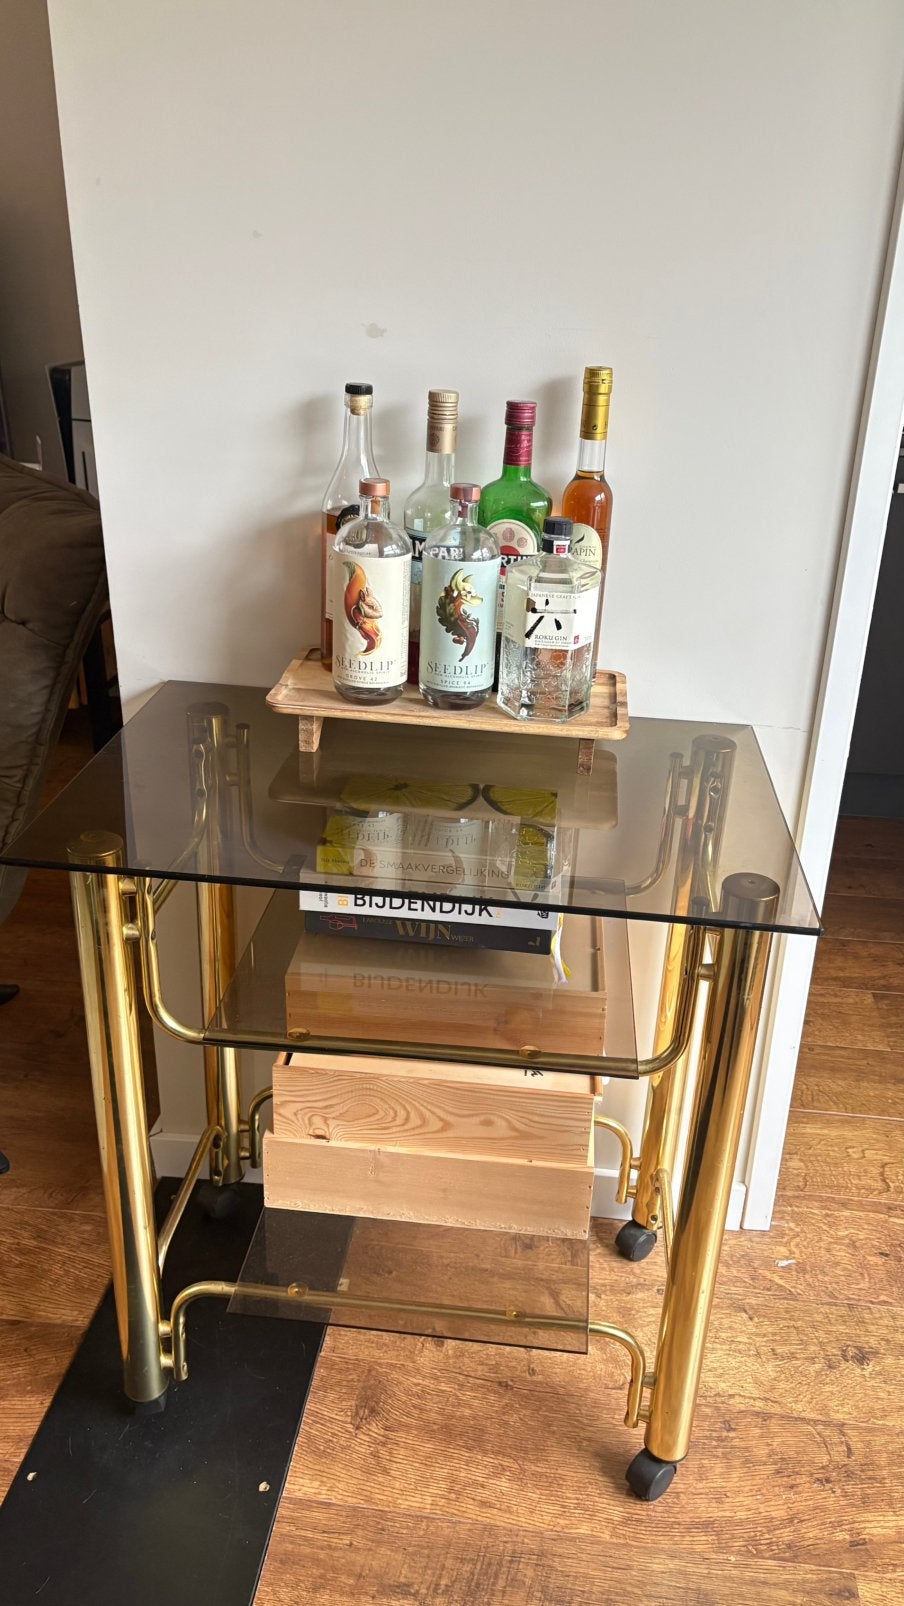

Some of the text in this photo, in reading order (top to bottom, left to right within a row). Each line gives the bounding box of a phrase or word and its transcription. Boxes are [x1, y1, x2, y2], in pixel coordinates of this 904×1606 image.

[335, 655, 393, 671] SEEDLIP
[427, 660, 486, 675] SEEDLIP
[345, 673, 366, 681] GROVE
[359, 858, 376, 869] DE
[378, 860, 510, 880] SMAAKVERGELIJKING
[353, 890, 494, 919] BIJDENDIJK
[394, 920, 453, 941] WIJN
